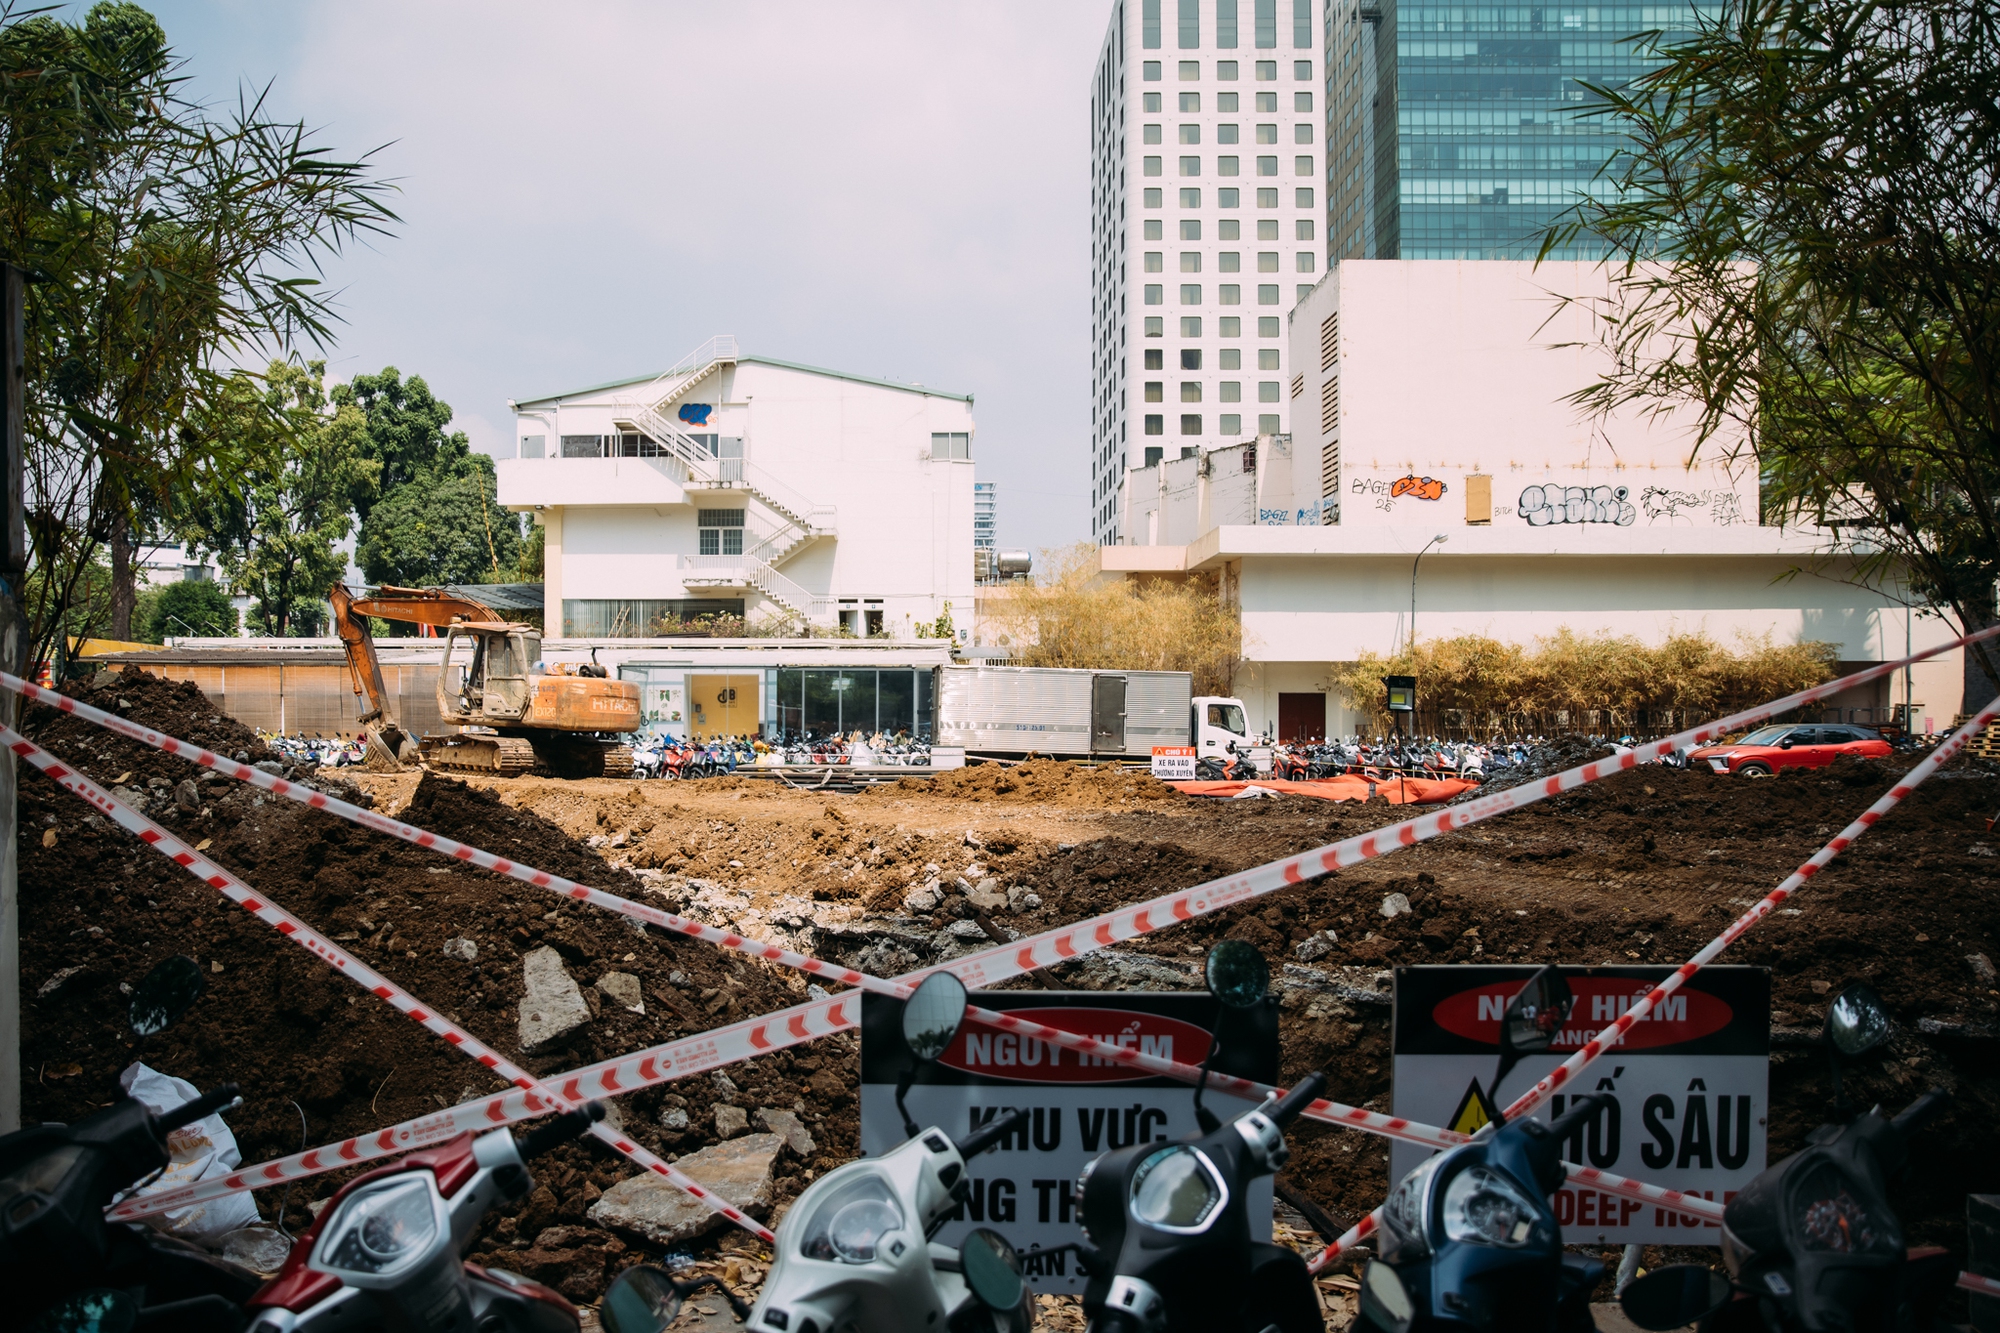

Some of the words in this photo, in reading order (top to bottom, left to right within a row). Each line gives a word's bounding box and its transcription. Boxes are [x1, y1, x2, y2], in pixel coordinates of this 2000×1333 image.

[965, 1032, 1063, 1066] NGUY
[1641, 1077, 1751, 1170] SÂU
[1554, 1189, 1642, 1227] DEEP
